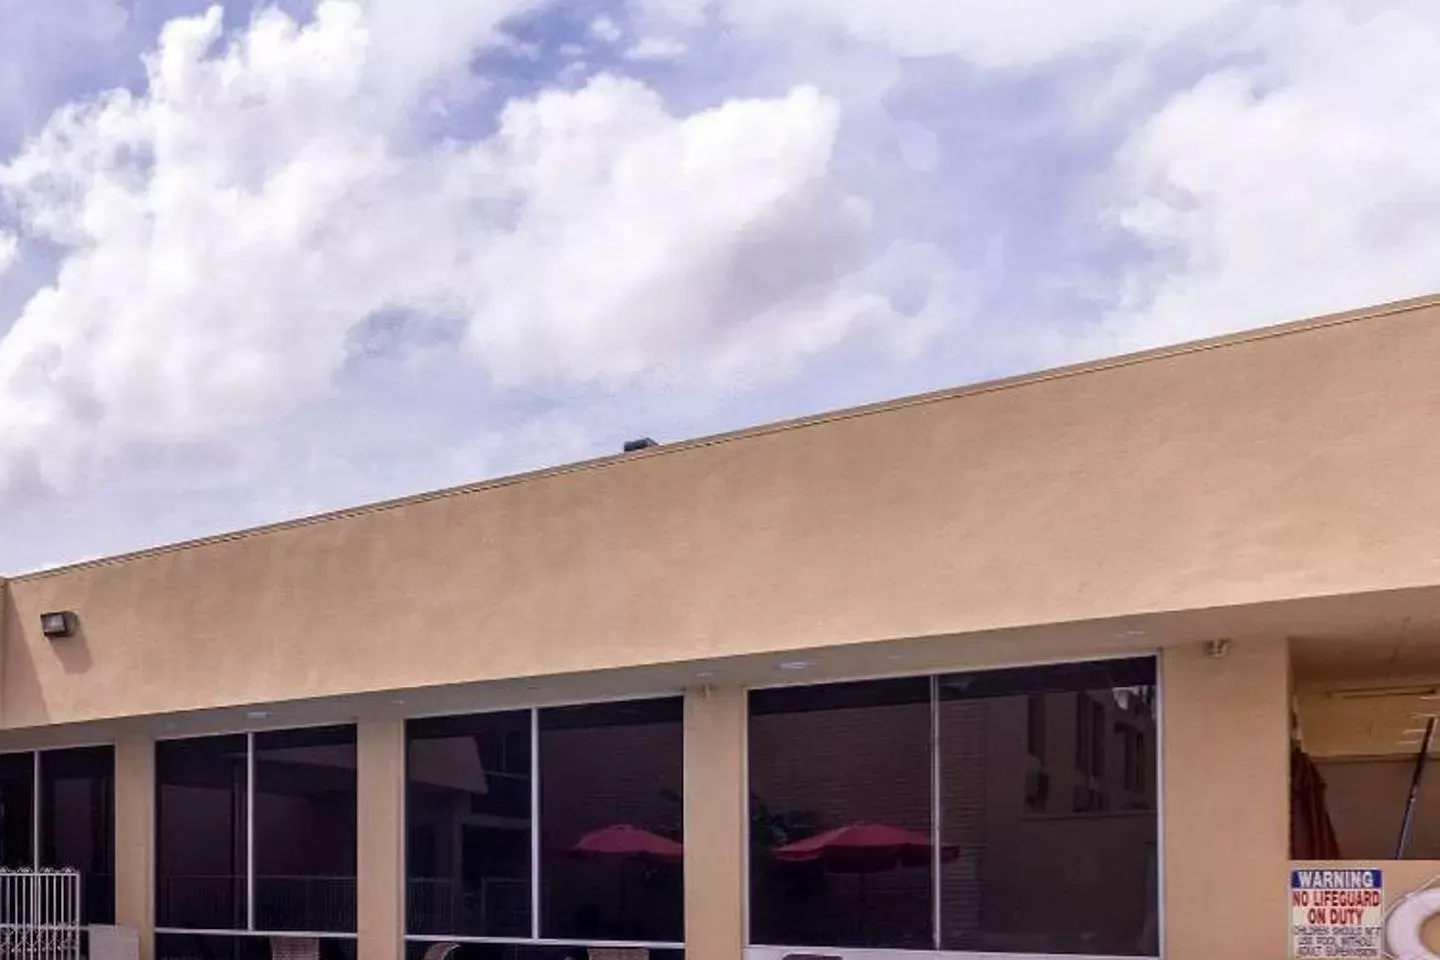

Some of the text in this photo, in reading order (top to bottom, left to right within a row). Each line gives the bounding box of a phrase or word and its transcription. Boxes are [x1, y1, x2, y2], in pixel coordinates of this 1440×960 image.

[1299, 871, 1373, 888] WARNING
[1292, 890, 1380, 907] NO LIFEGUARD
[1307, 908, 1364, 924] ON DUTY
